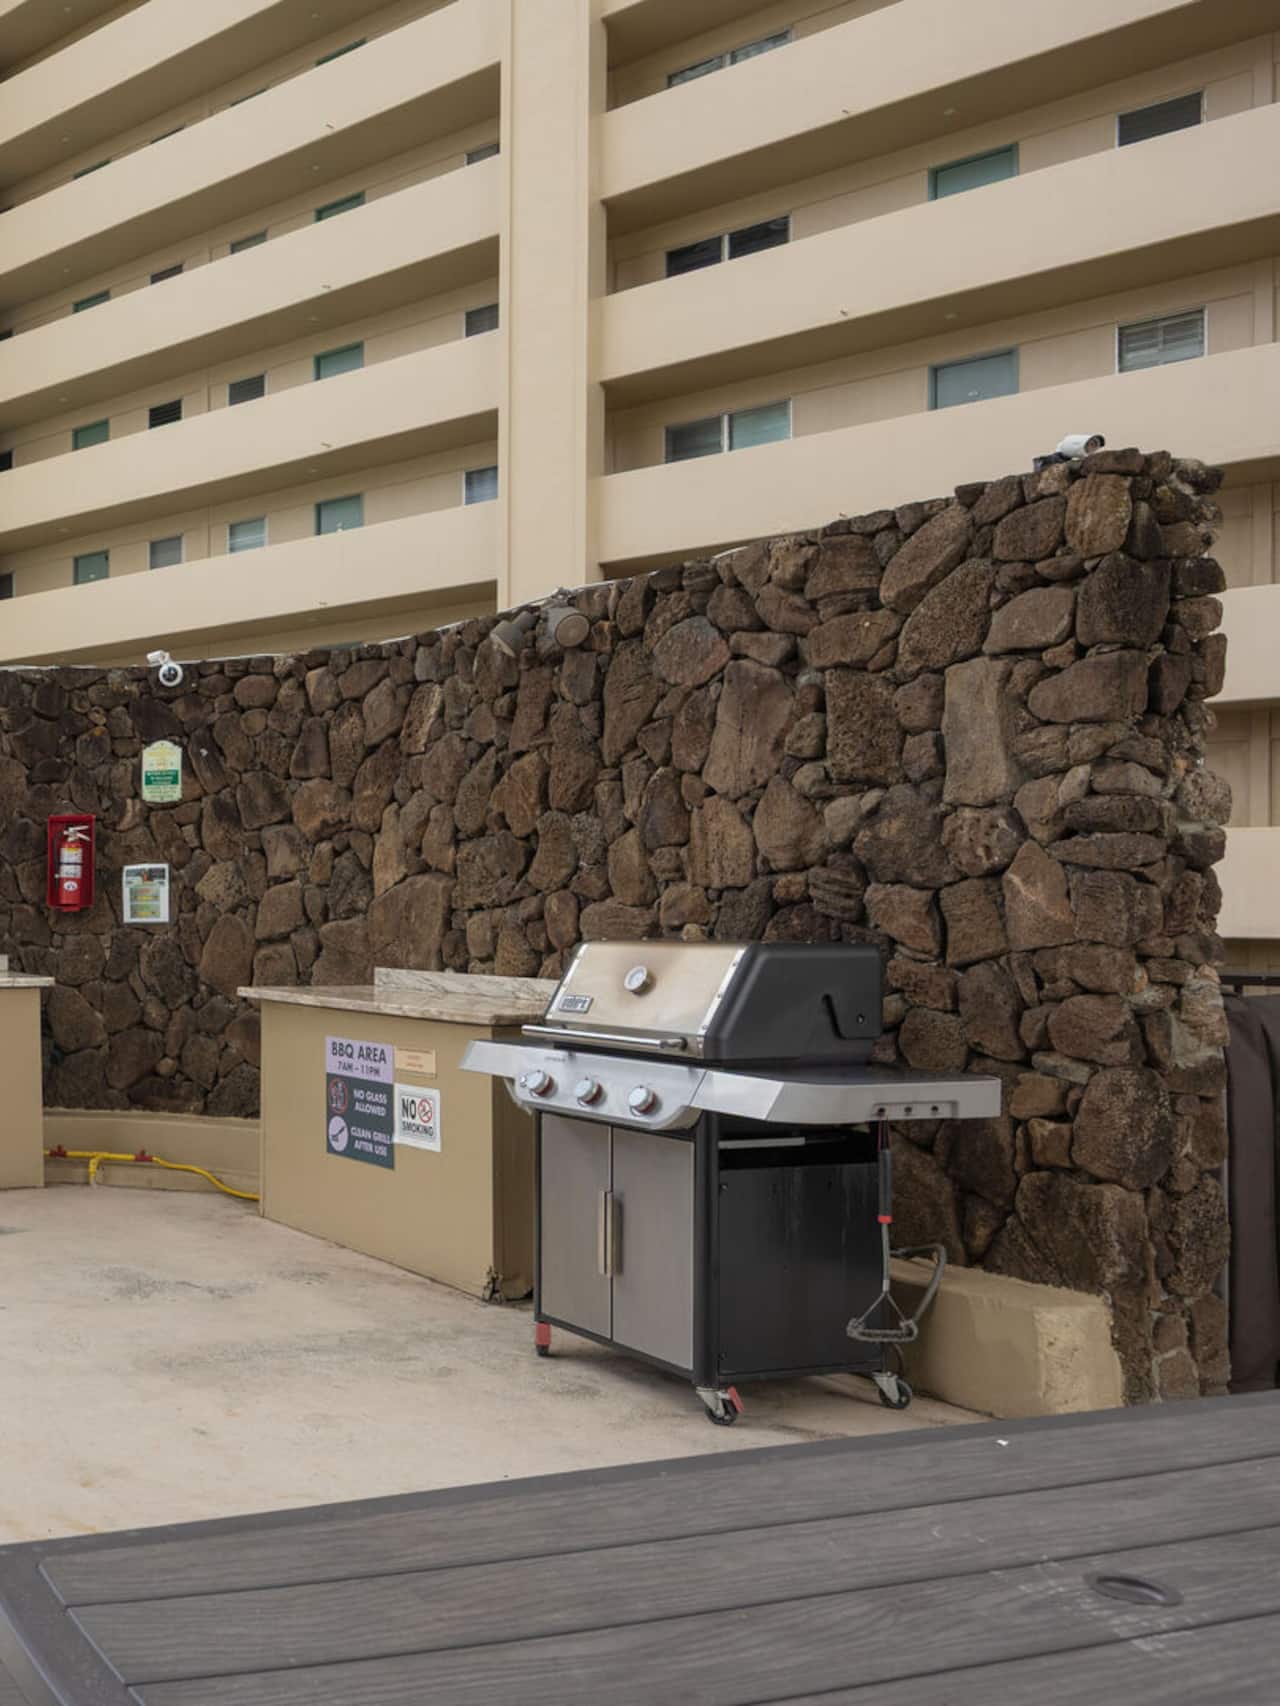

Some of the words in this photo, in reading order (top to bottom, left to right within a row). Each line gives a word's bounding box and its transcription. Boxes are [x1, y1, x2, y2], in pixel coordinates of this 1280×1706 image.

[332, 1041, 354, 1059] BBQ
[358, 1045, 387, 1065] AREA
[338, 1060, 353, 1072] 7AM
[361, 1064, 380, 1077] 11PM
[353, 1089, 364, 1100] NO
[366, 1091, 387, 1105] GLASS
[355, 1101, 386, 1117] ALLOWED
[401, 1098, 417, 1120] NO
[350, 1127, 371, 1140] CLEAN
[402, 1121, 433, 1137] SMOKING
[354, 1140, 373, 1153] AFTER
[375, 1144, 387, 1157] USE
